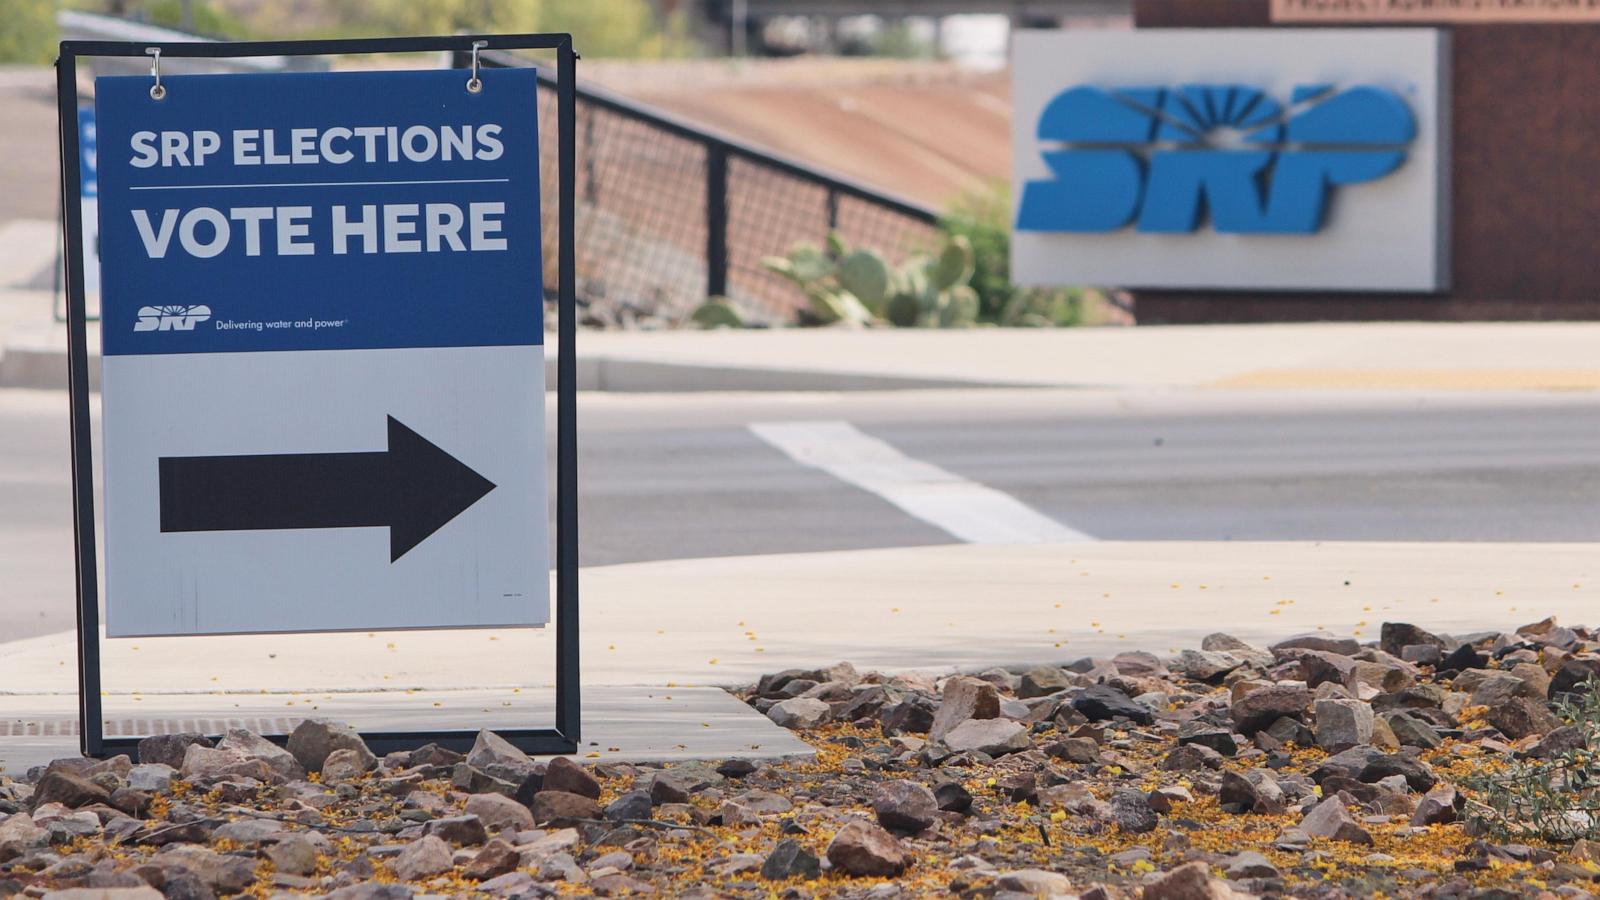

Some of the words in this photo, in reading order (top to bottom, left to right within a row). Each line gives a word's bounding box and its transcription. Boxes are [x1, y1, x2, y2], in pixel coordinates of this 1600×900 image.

[129, 130, 221, 168] SRP
[232, 123, 505, 166] ELECTIONS
[1015, 83, 1418, 235] SRP
[130, 205, 315, 259] VOTE
[331, 201, 508, 255] HERE
[133, 304, 212, 332] SRP
[215, 319, 263, 332] Delivering
[265, 320, 292, 329] water
[294, 317, 313, 328] and
